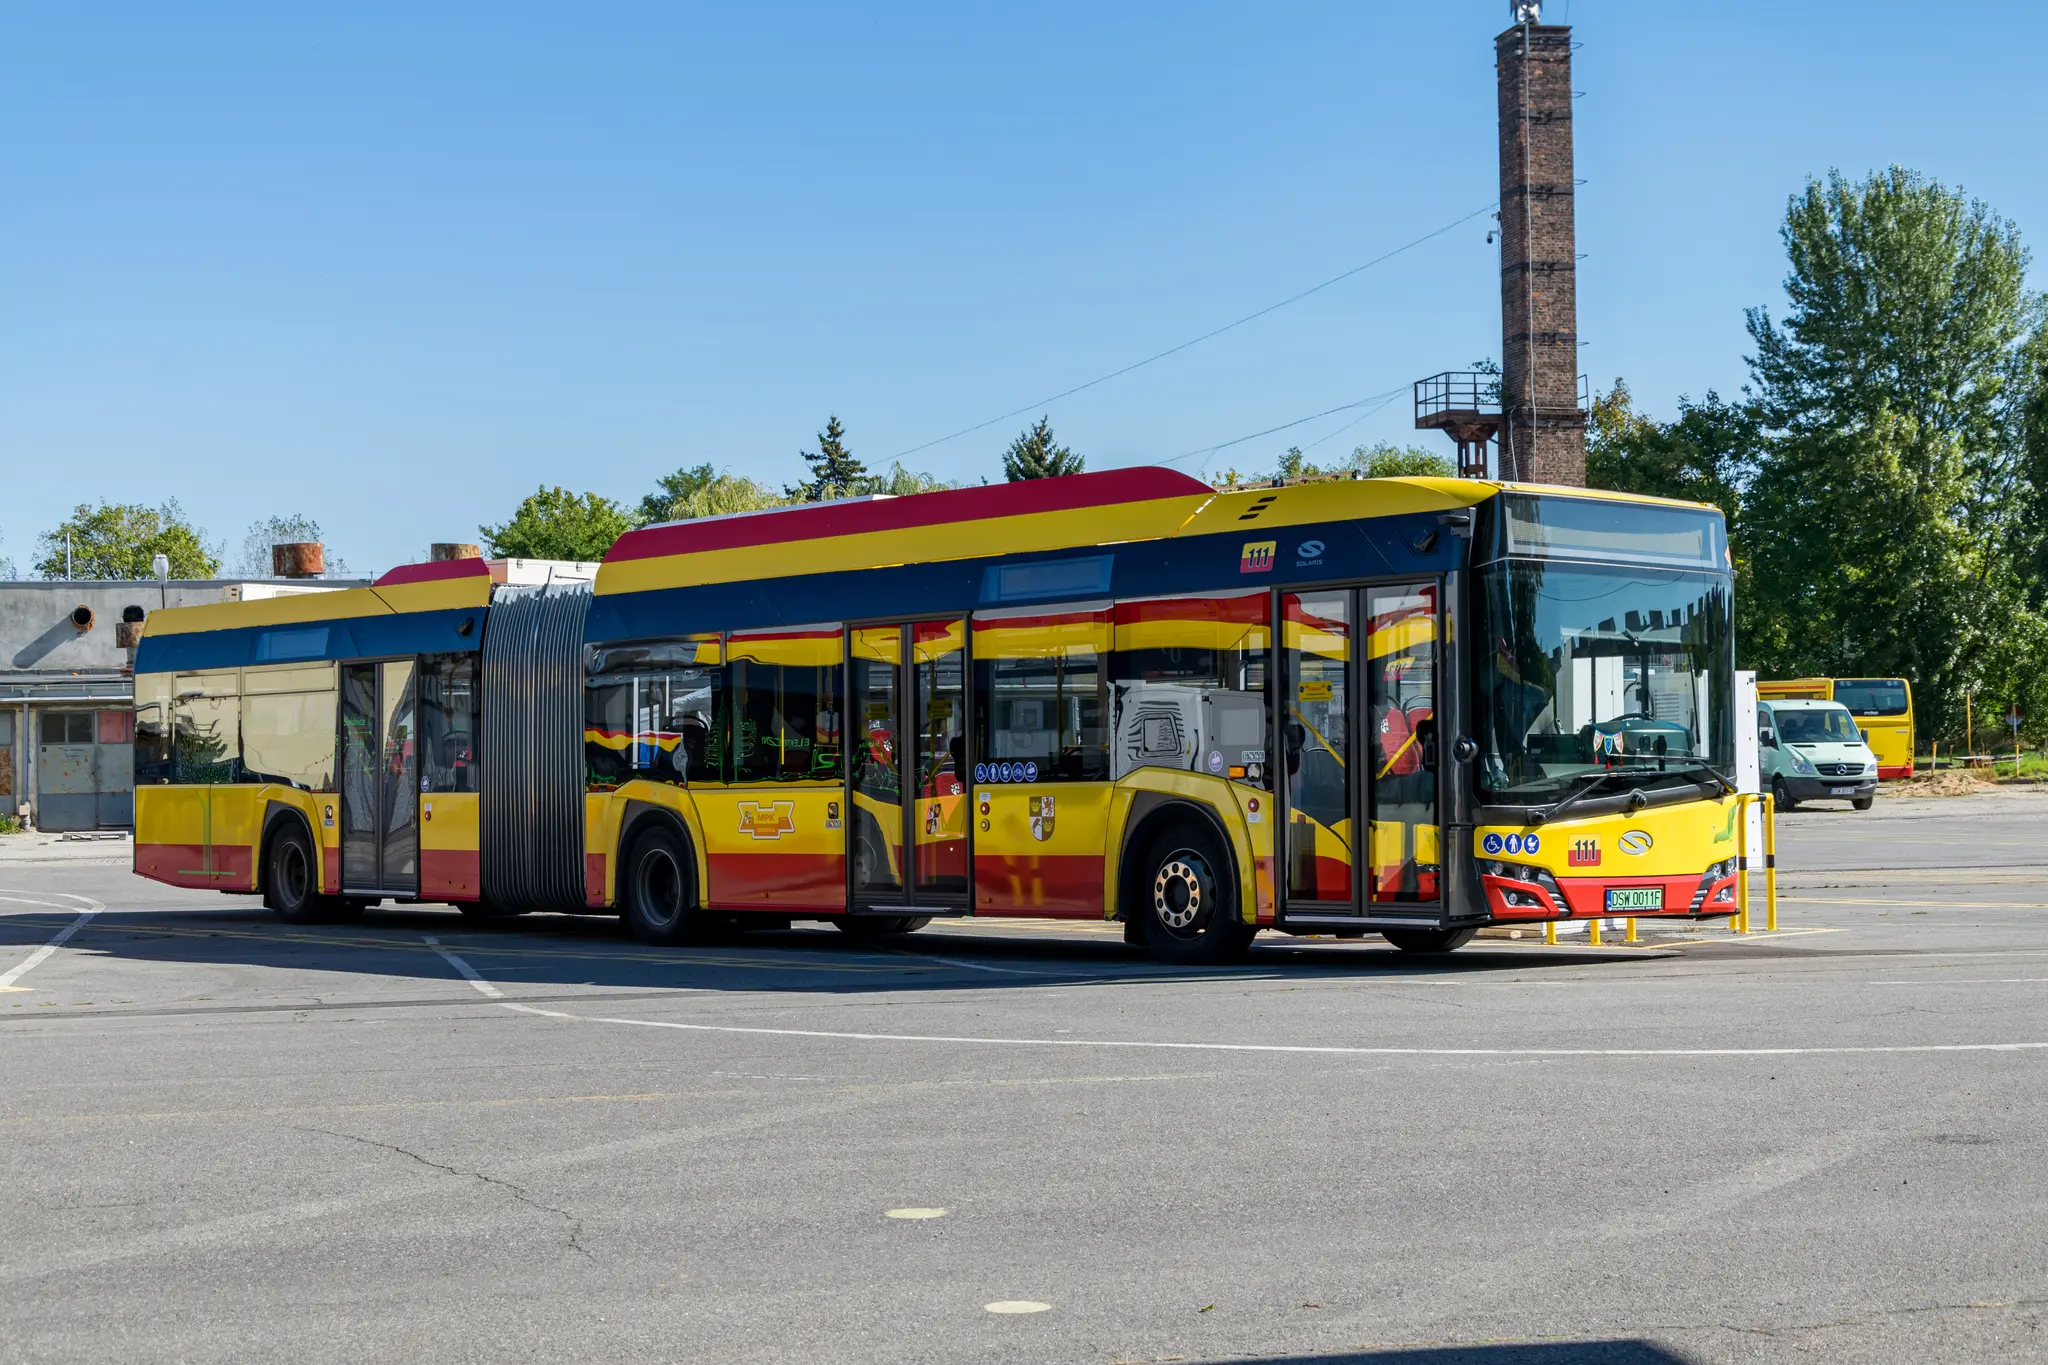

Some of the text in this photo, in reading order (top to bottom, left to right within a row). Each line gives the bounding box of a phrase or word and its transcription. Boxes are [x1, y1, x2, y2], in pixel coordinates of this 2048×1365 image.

[1247, 546, 1271, 568] 111
[1296, 559, 1324, 567] SOLARIS
[757, 813, 775, 822] MPK
[1574, 839, 1596, 862] 111
[1612, 890, 1661, 906] DSW 0011F
